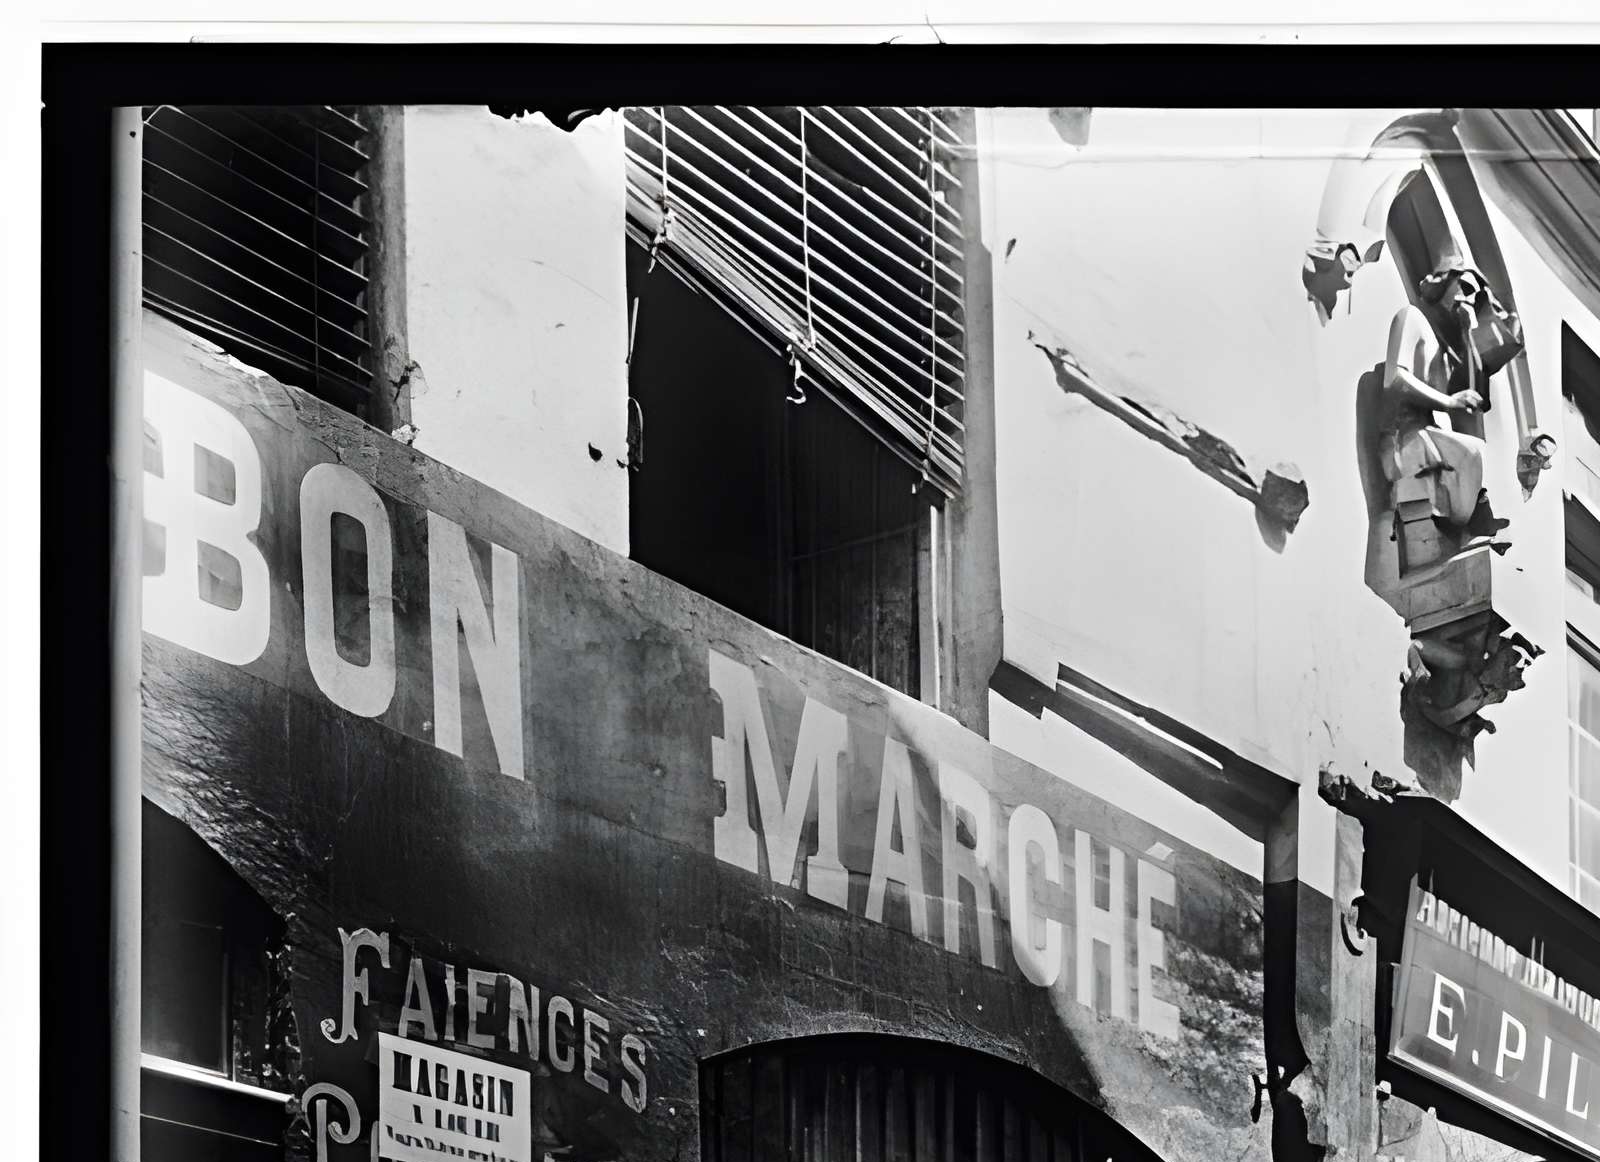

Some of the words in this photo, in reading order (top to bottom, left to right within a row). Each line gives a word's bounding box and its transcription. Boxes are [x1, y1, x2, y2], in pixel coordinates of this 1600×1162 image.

[142, 368, 526, 782] BON
[708, 648, 1182, 1042] MARCHÉ
[392, 1050, 514, 1118] MAGASIN
